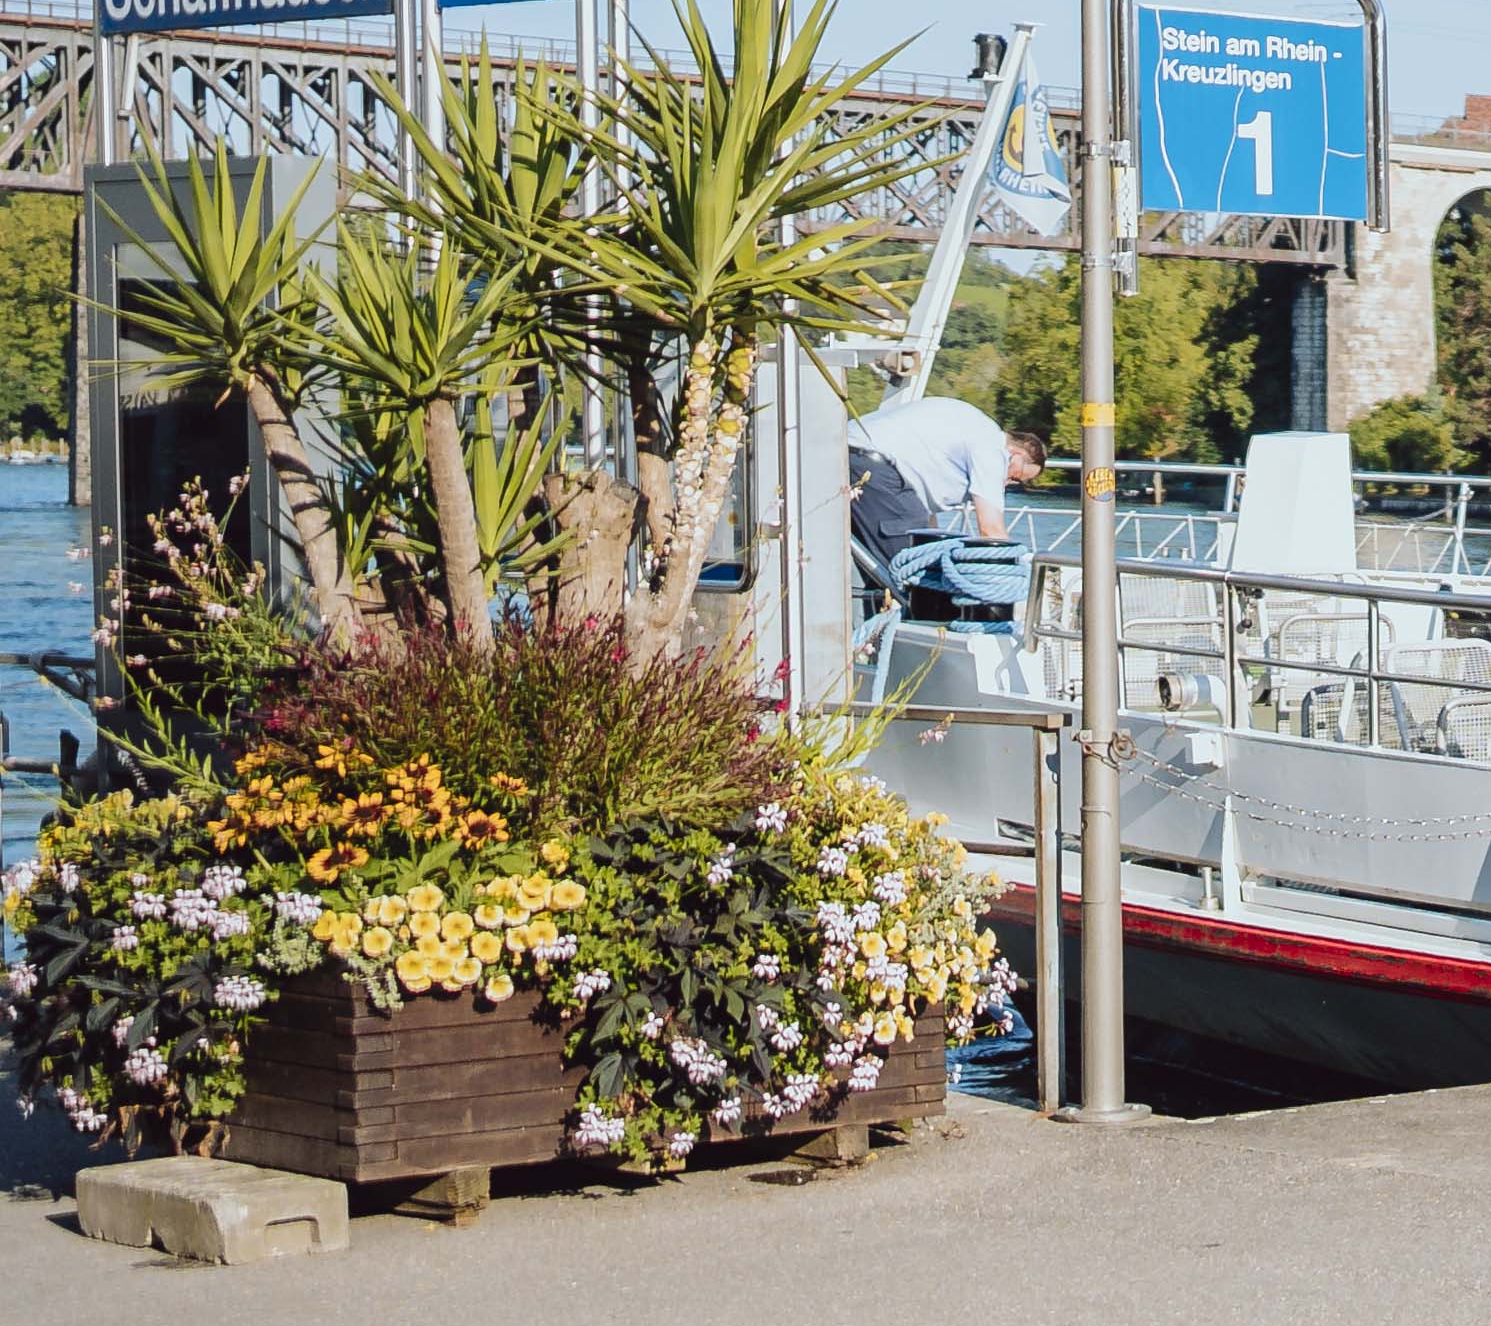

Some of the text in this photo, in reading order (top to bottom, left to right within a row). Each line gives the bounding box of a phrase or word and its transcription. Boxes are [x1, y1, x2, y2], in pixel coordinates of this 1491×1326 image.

[1162, 27, 1219, 53] Stein
[1226, 39, 1260, 57] am
[1266, 35, 1328, 62] Rhein
[1162, 58, 1292, 93] Kreuzlingen
[1238, 111, 1273, 195] 1
